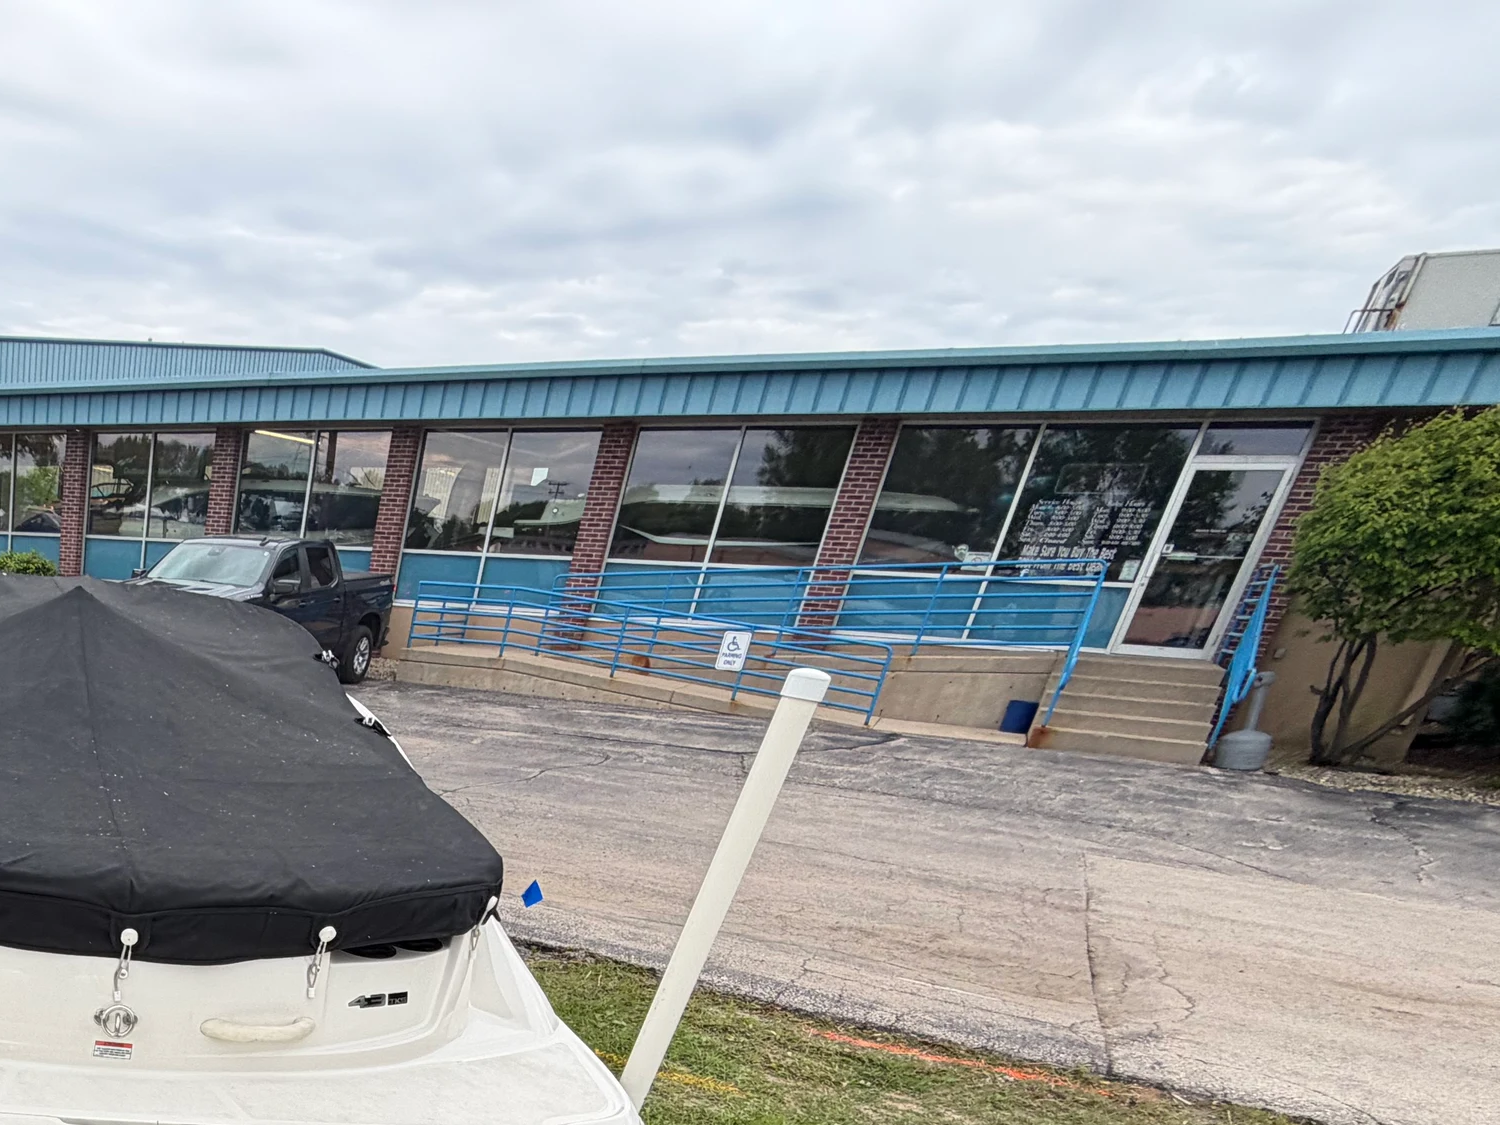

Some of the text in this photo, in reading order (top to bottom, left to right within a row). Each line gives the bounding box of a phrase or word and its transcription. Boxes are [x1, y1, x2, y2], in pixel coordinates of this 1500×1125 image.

[1020, 545, 1118, 561] Make Sure You Buy The Best
